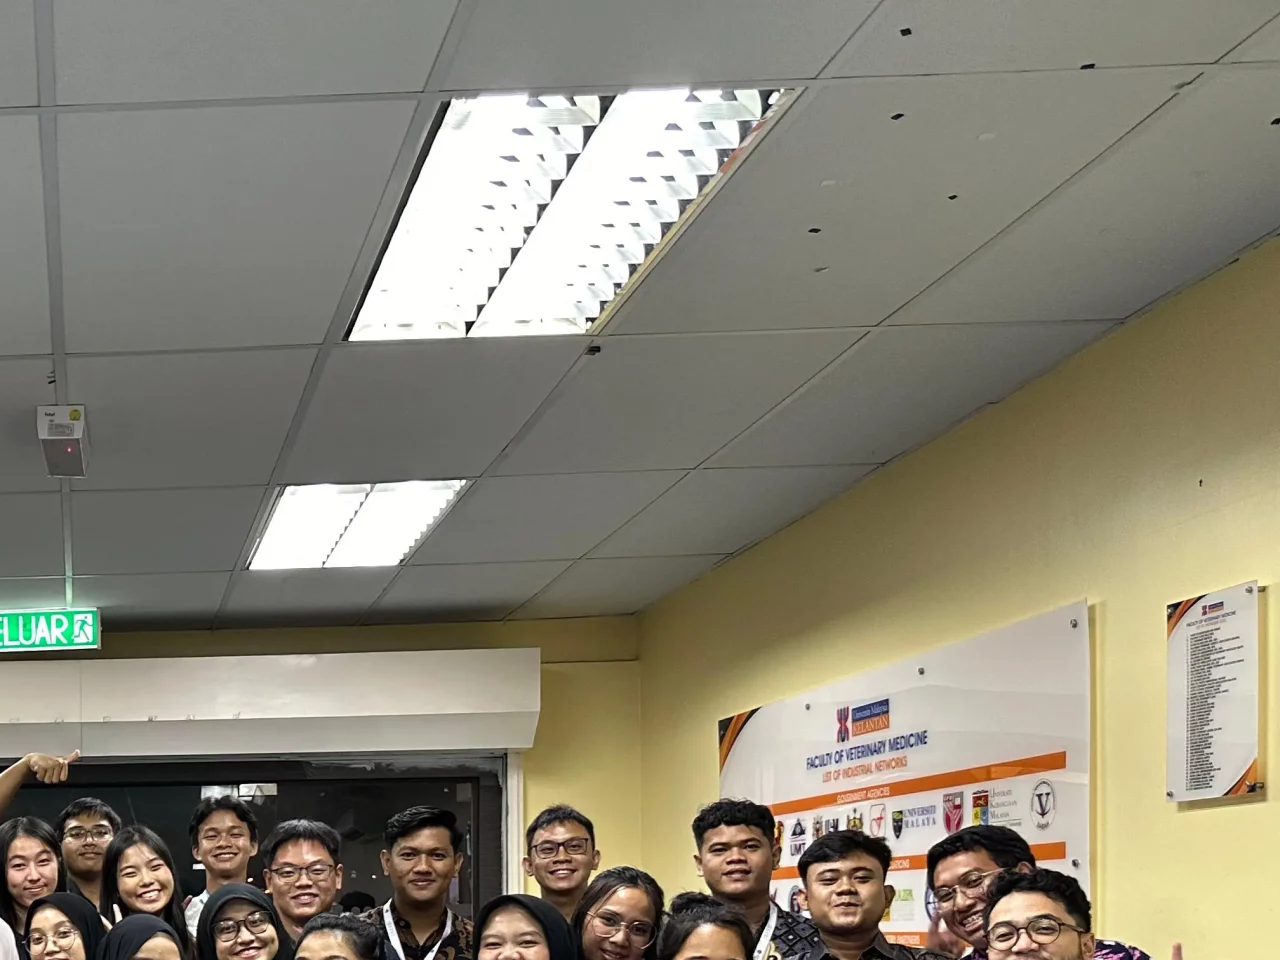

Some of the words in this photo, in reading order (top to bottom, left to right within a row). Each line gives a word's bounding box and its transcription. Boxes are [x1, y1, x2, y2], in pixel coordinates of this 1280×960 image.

[806, 751, 832, 770] FACULTY
[834, 749, 844, 764] OF
[845, 740, 887, 762] VETERINARY
[888, 730, 928, 752] MEDICINE
[822, 771, 832, 783] LIST
[833, 769, 841, 781] OF
[842, 763, 873, 779] INDUSTRIAL
[874, 756, 908, 773] NETWORKS
[836, 790, 867, 804] GOVERNMENT
[867, 786, 890, 799] AGENCIES
[903, 805, 936, 818] UNIVERSITI
[903, 816, 937, 829] MALAYA
[789, 842, 806, 856] UMT
